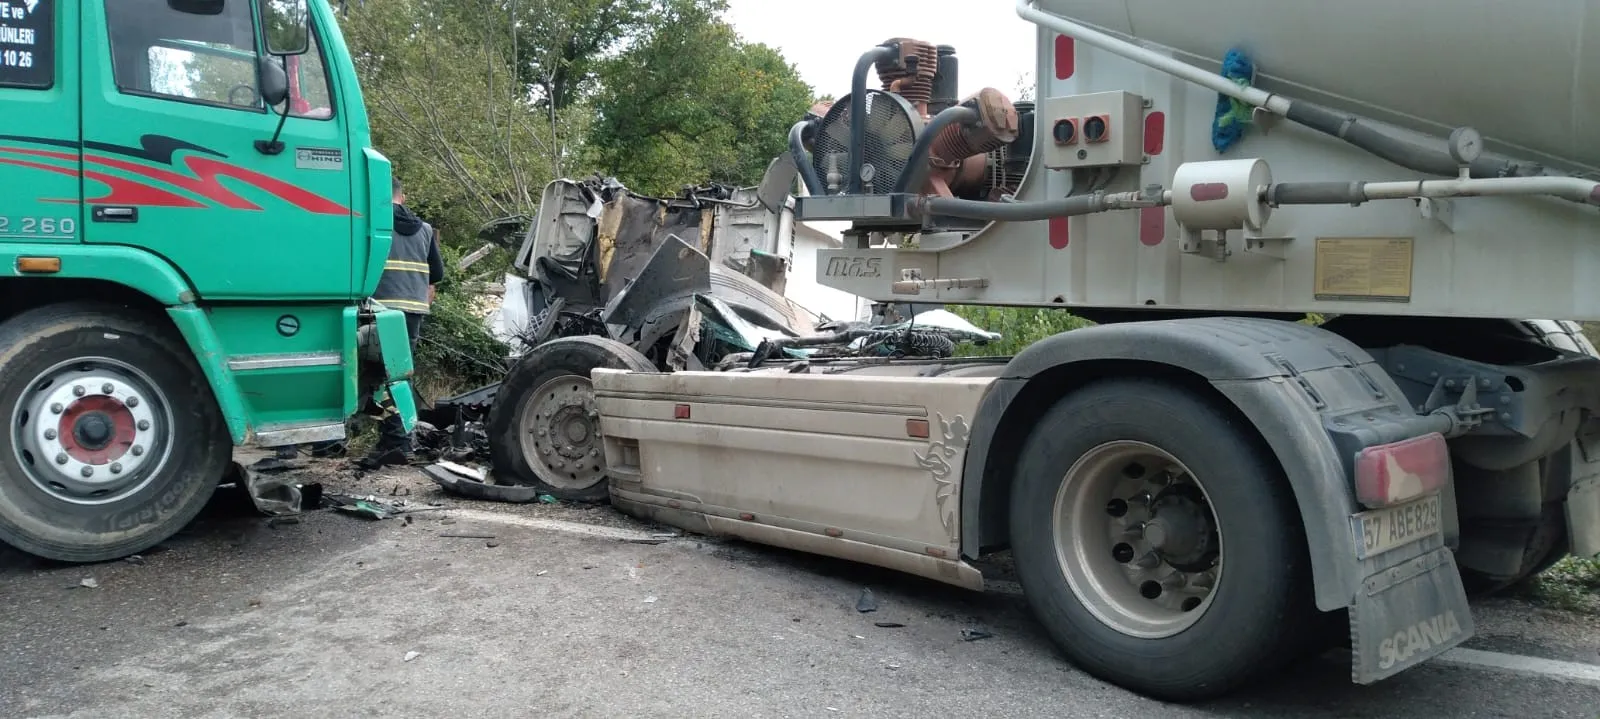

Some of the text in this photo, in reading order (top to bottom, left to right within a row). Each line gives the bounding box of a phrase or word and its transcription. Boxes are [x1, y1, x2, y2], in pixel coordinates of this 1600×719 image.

[11, 7, 24, 19] ve
[4, 50, 17, 66] 10
[19, 51, 32, 68] 26
[1379, 610, 1461, 669] SCANIA
